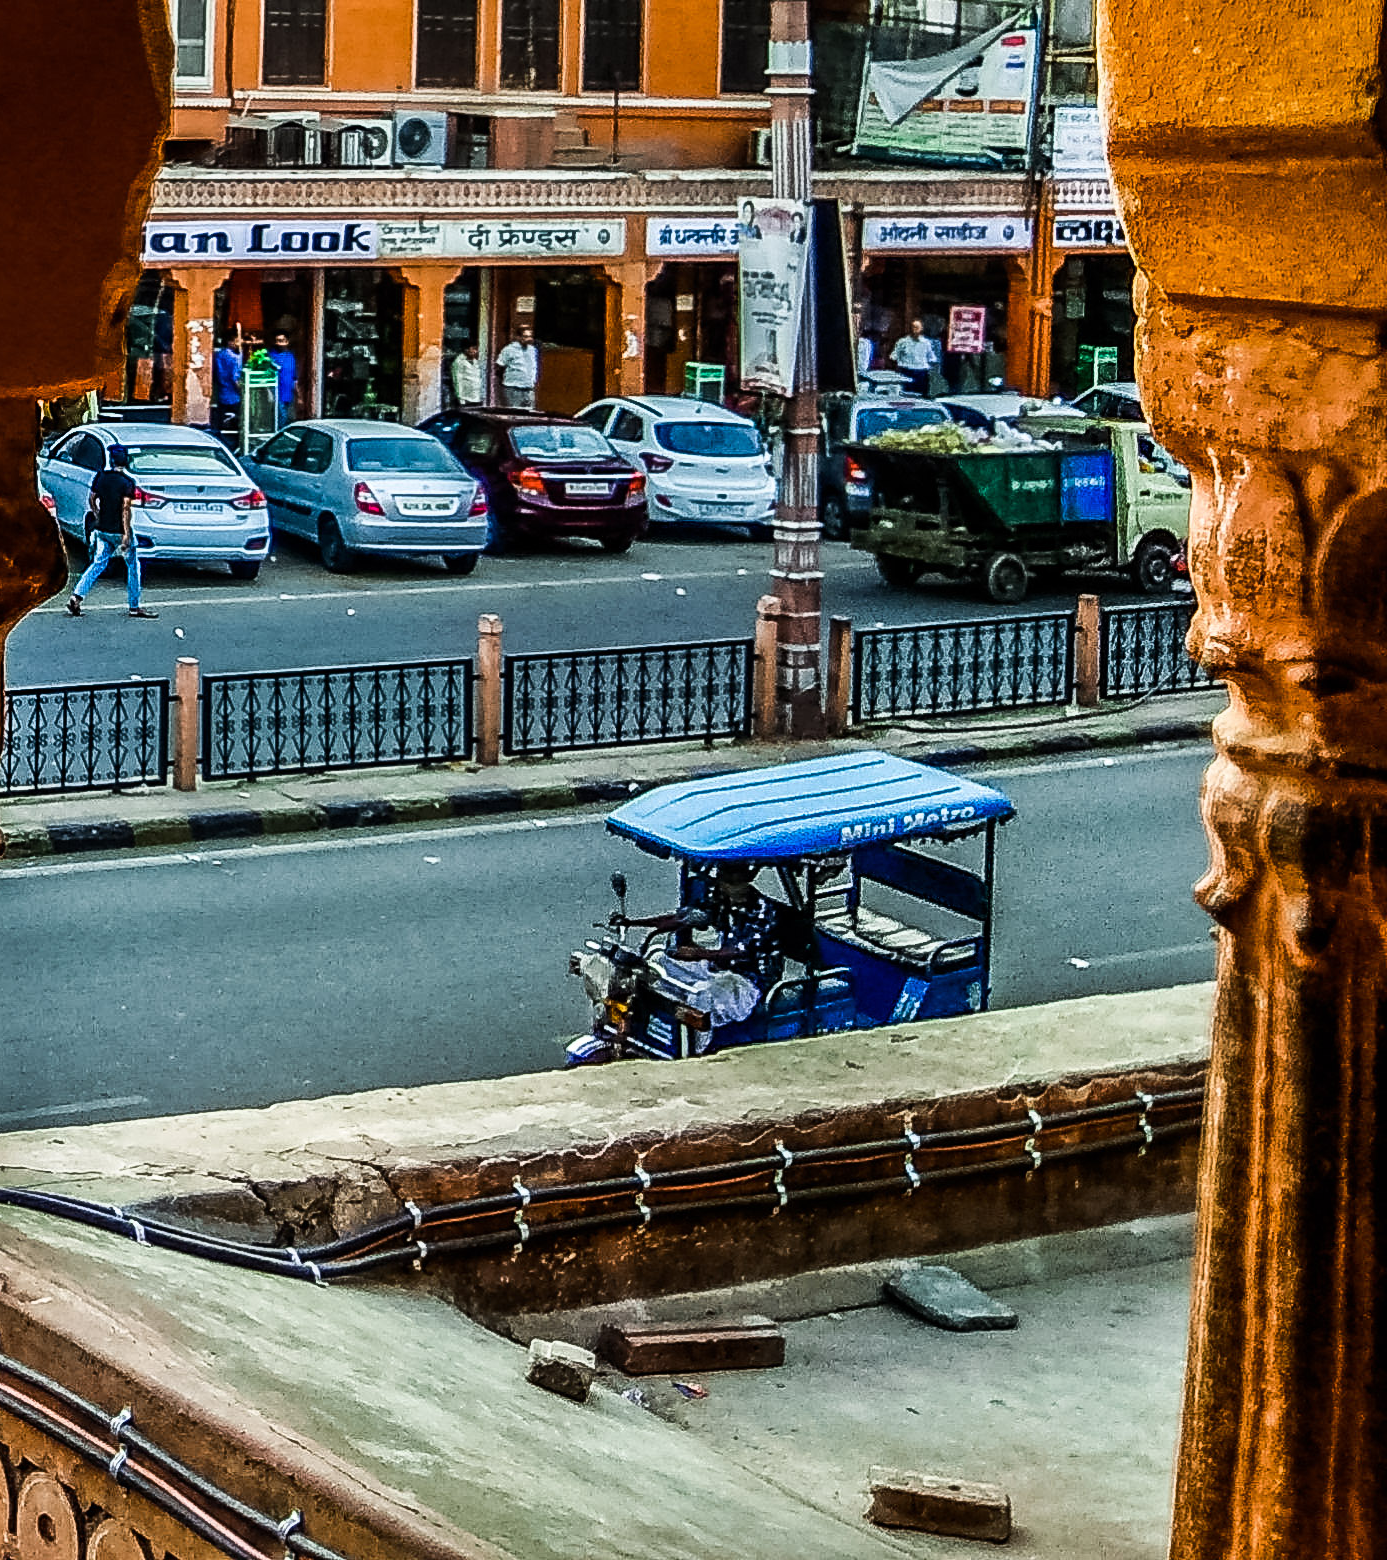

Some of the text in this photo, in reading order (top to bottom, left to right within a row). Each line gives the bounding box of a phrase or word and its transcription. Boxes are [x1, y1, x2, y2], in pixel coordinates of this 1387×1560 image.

[246, 223, 371, 253] Look
[841, 806, 976, 842] Mini Metro
